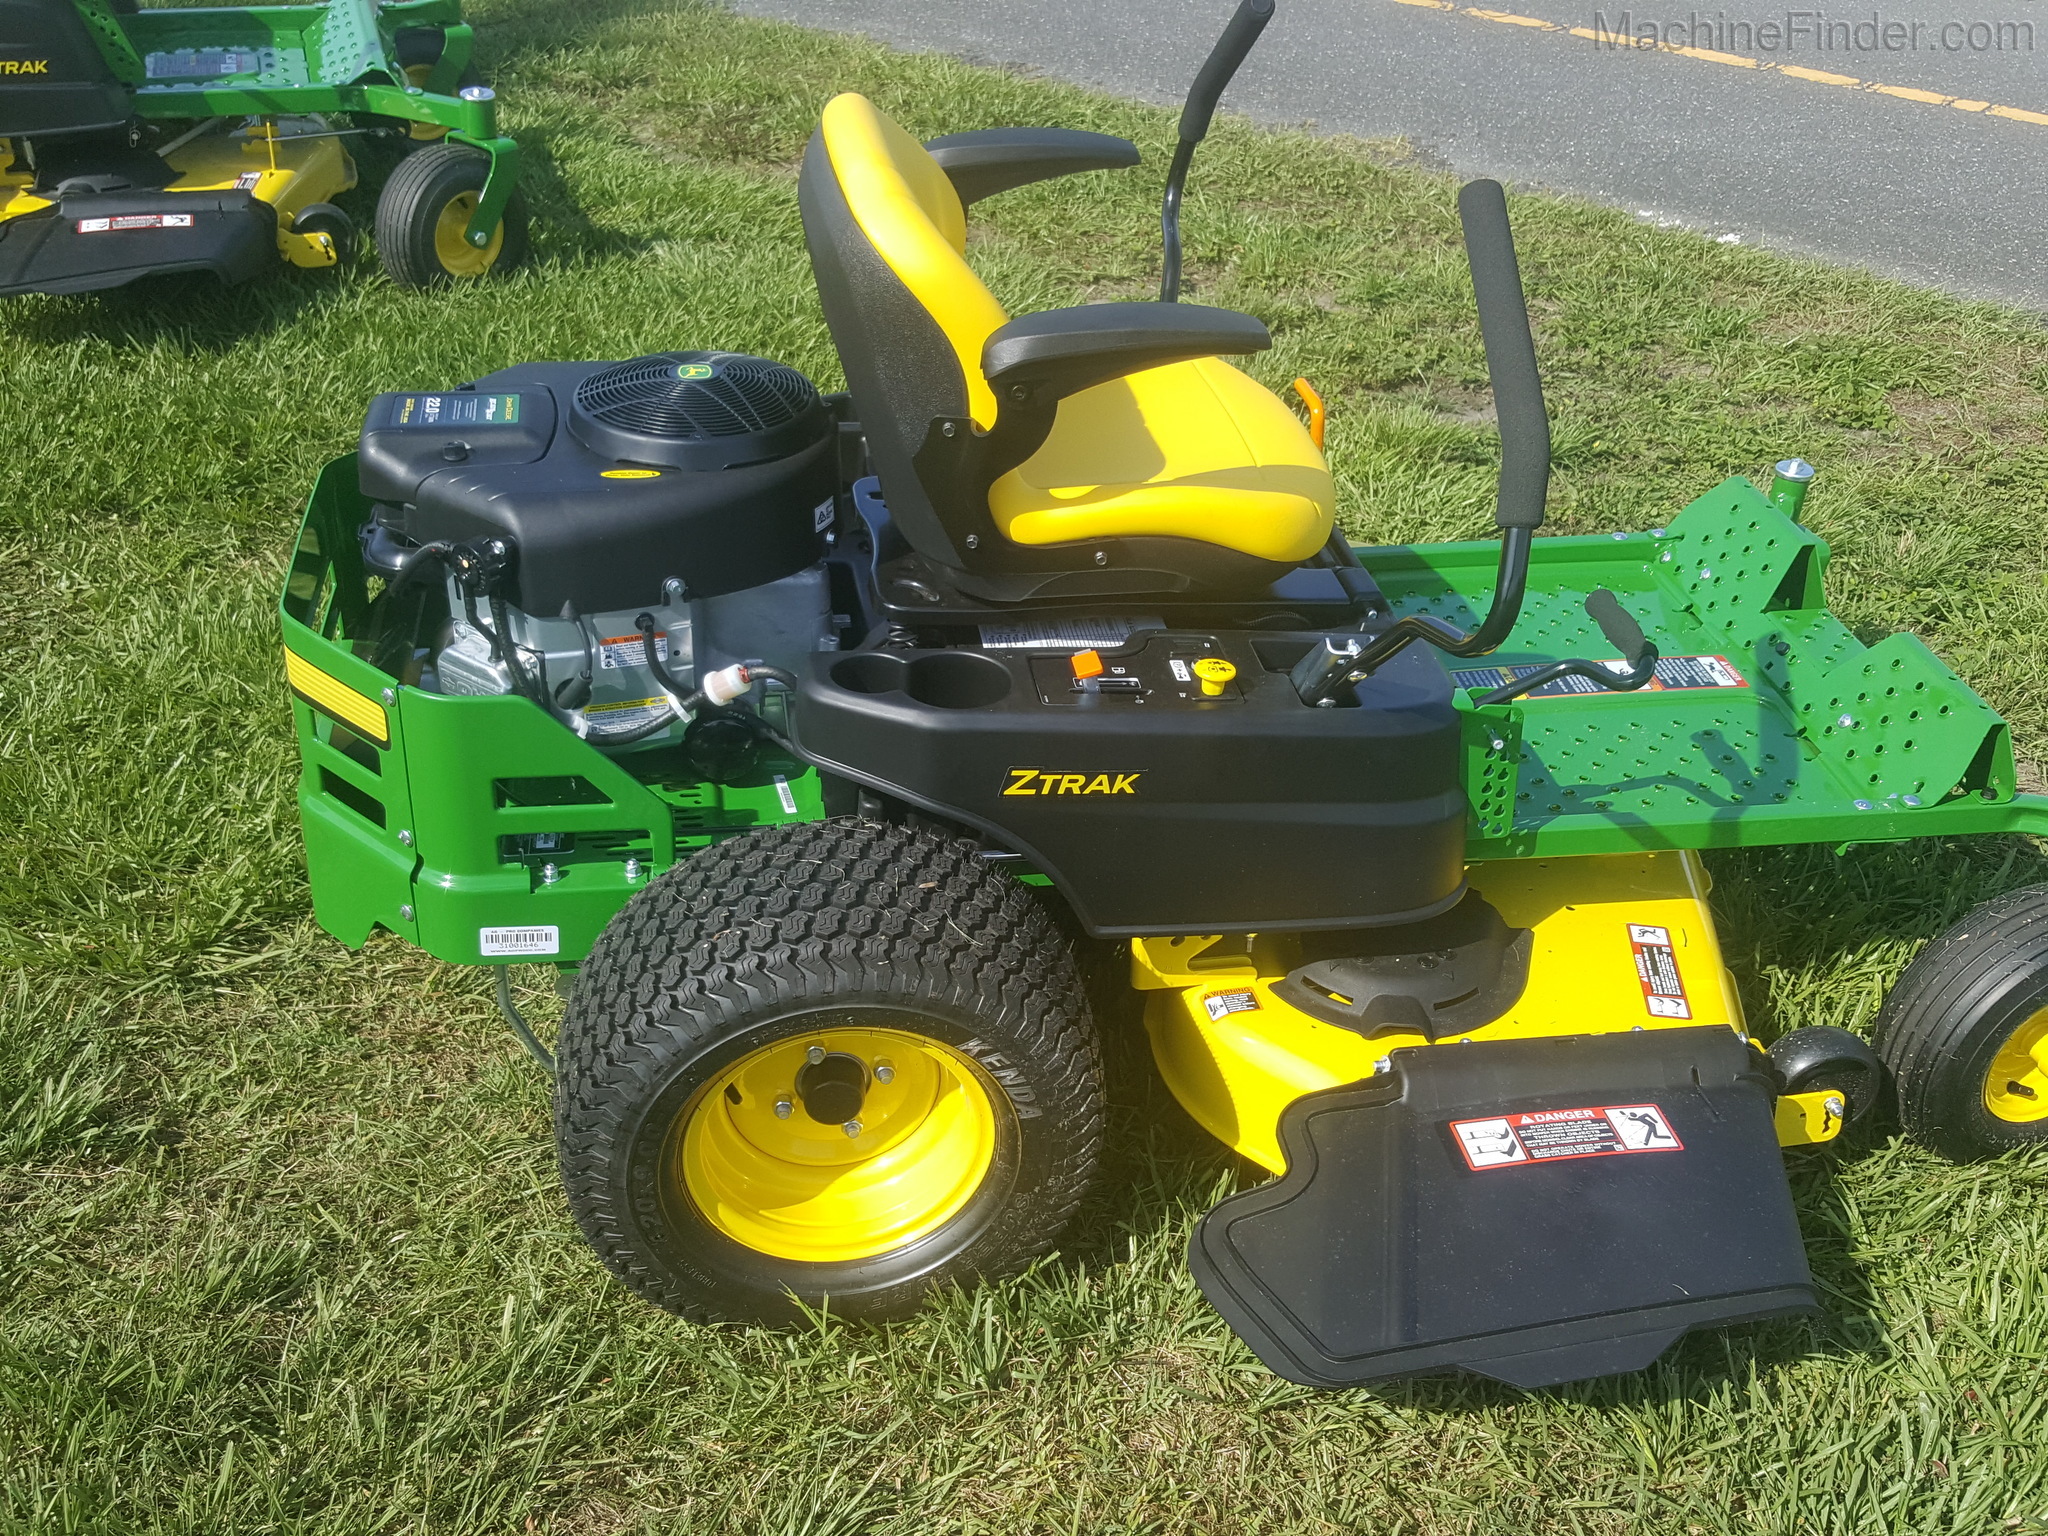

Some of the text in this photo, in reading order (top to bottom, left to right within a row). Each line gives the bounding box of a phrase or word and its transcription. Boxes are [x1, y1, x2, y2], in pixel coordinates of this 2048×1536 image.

[1003, 770, 1141, 795] ZTRAK
[1635, 953, 1648, 977] DANGER
[1211, 988, 1250, 996] WARNING
[955, 1037, 1043, 1119] KENDA
[1534, 1110, 1595, 1122] DANGER
